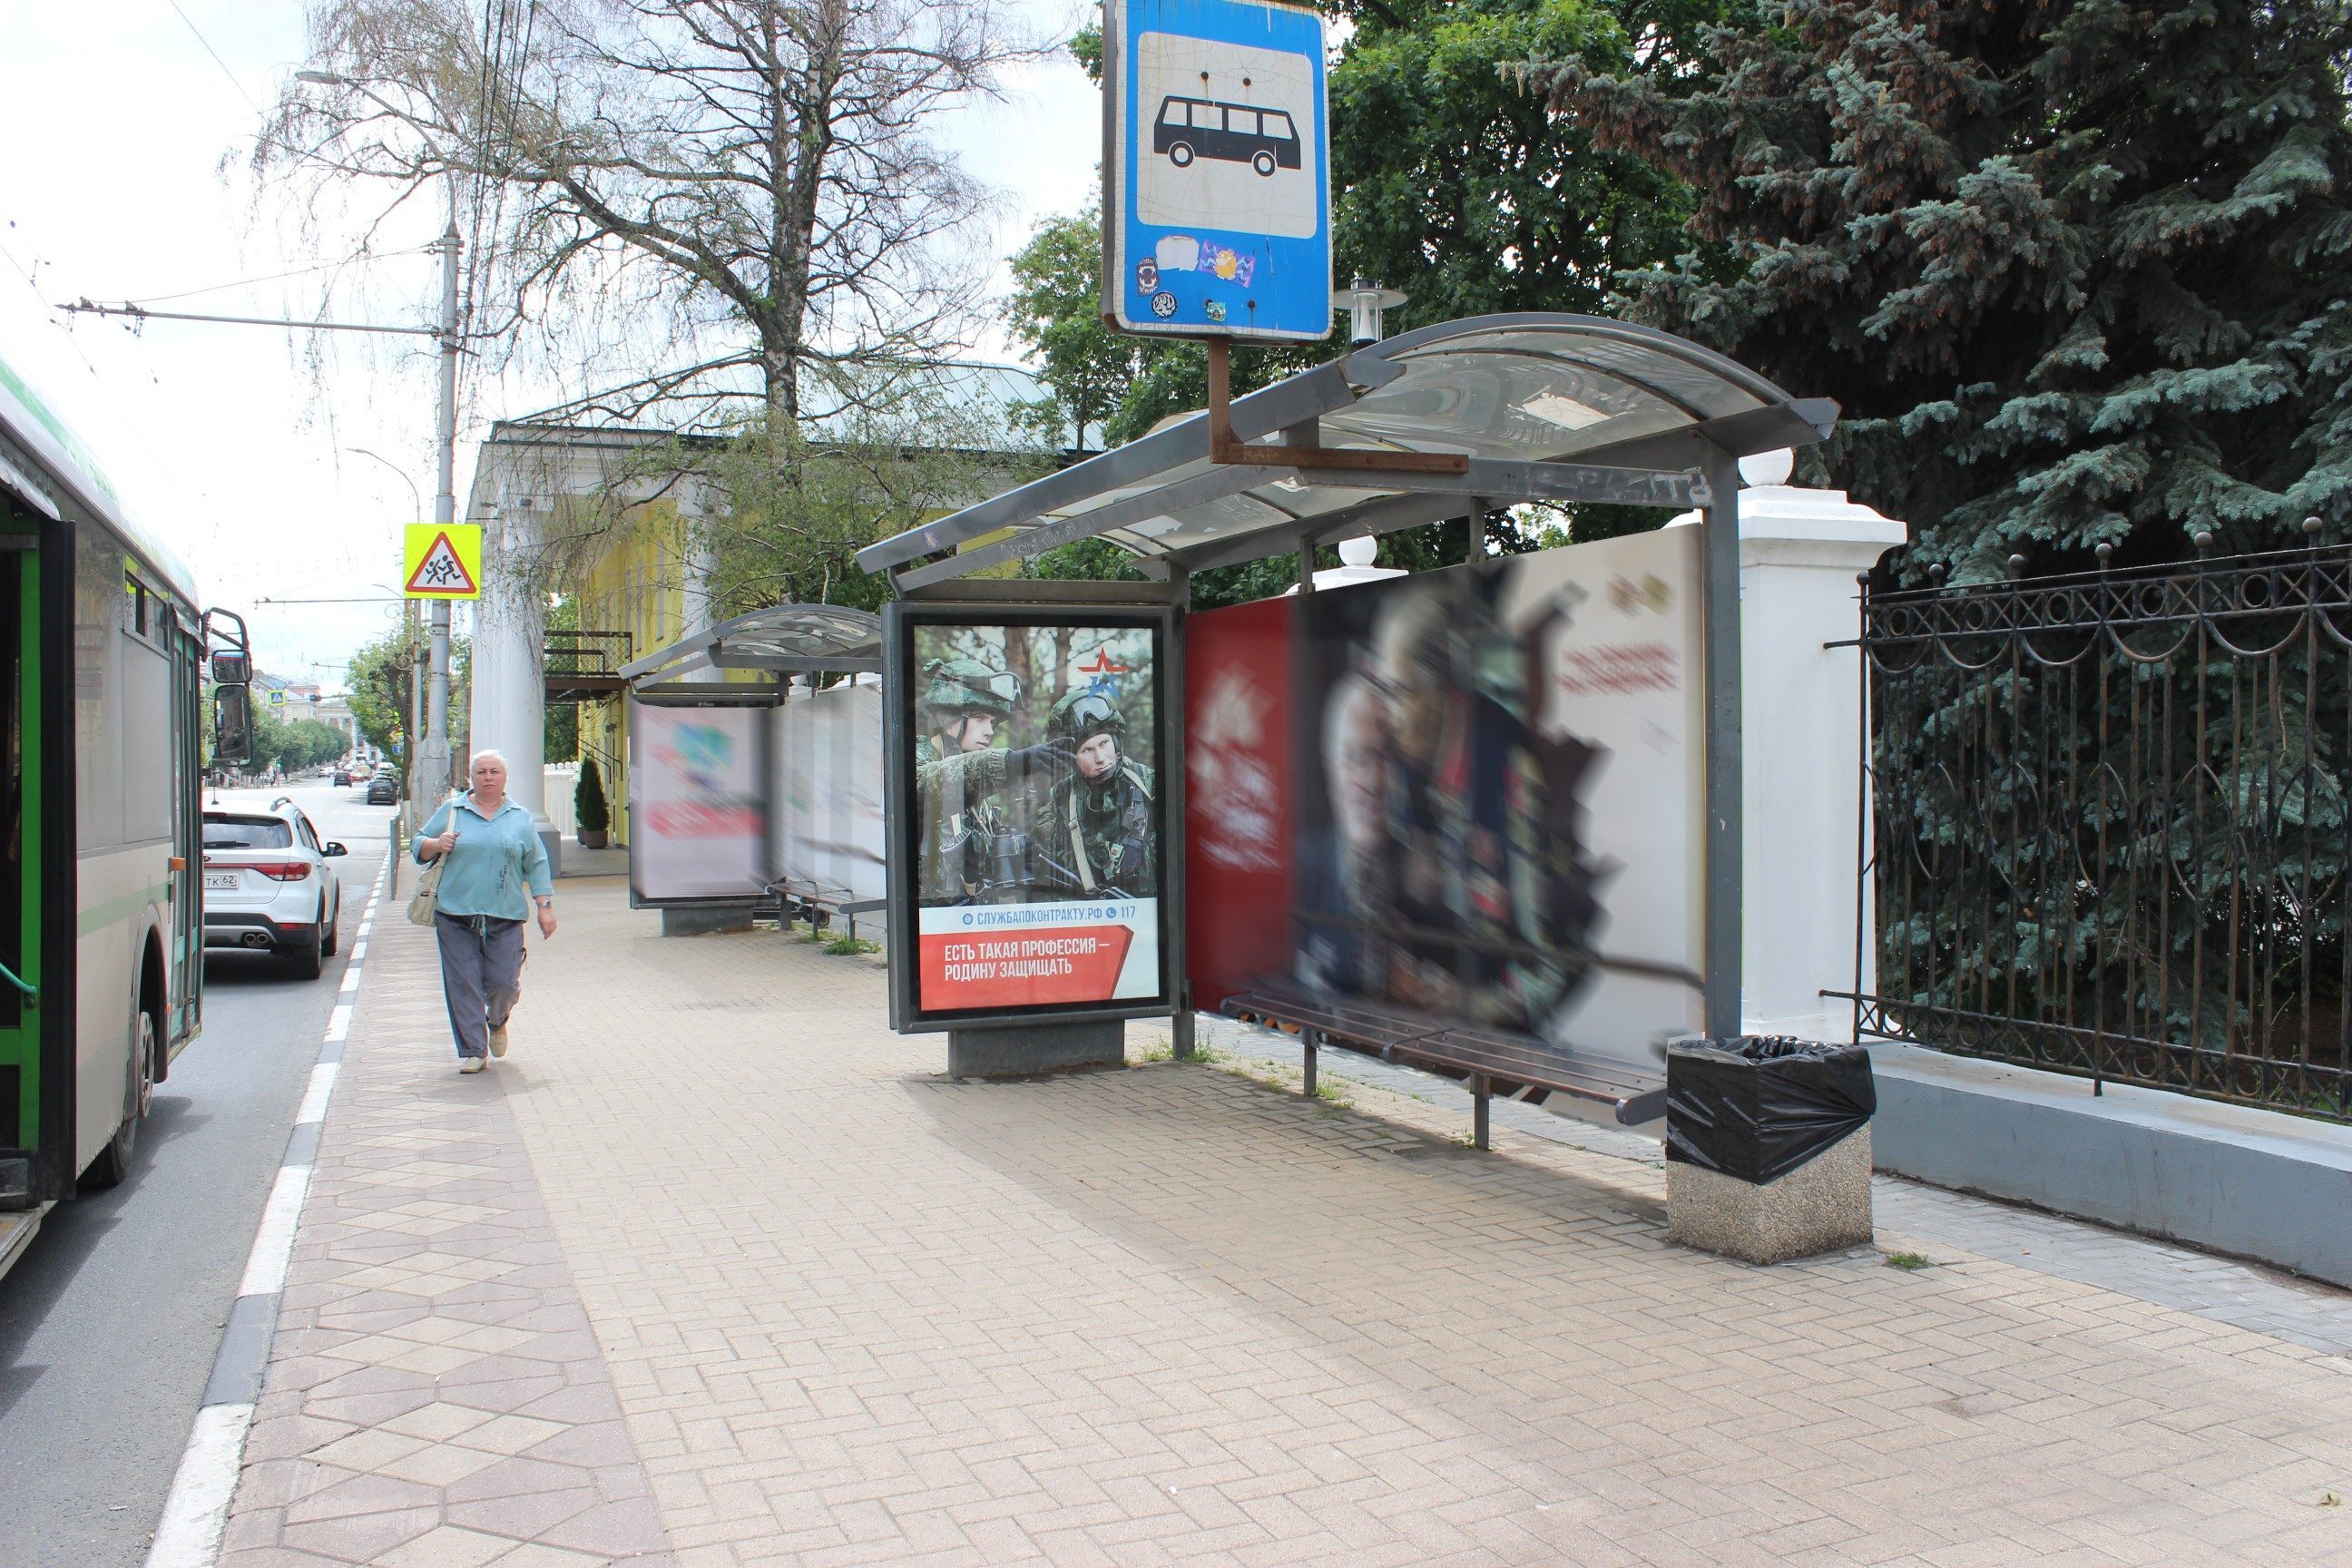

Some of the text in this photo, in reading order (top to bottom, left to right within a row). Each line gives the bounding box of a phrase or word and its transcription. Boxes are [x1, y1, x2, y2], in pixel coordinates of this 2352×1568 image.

[222, 875, 234, 884] 62
[977, 906, 1136, 925] СЛУЖБАПОКОНТРАКТУ.РФ 117
[945, 944, 975, 961] ЕСТЬ
[977, 941, 1018, 959] ТАКАЯ
[1021, 937, 1096, 957] ПРОФЕССИЯ
[945, 957, 1073, 983] РОДИНУ ЗАЩИЩАТЬ
